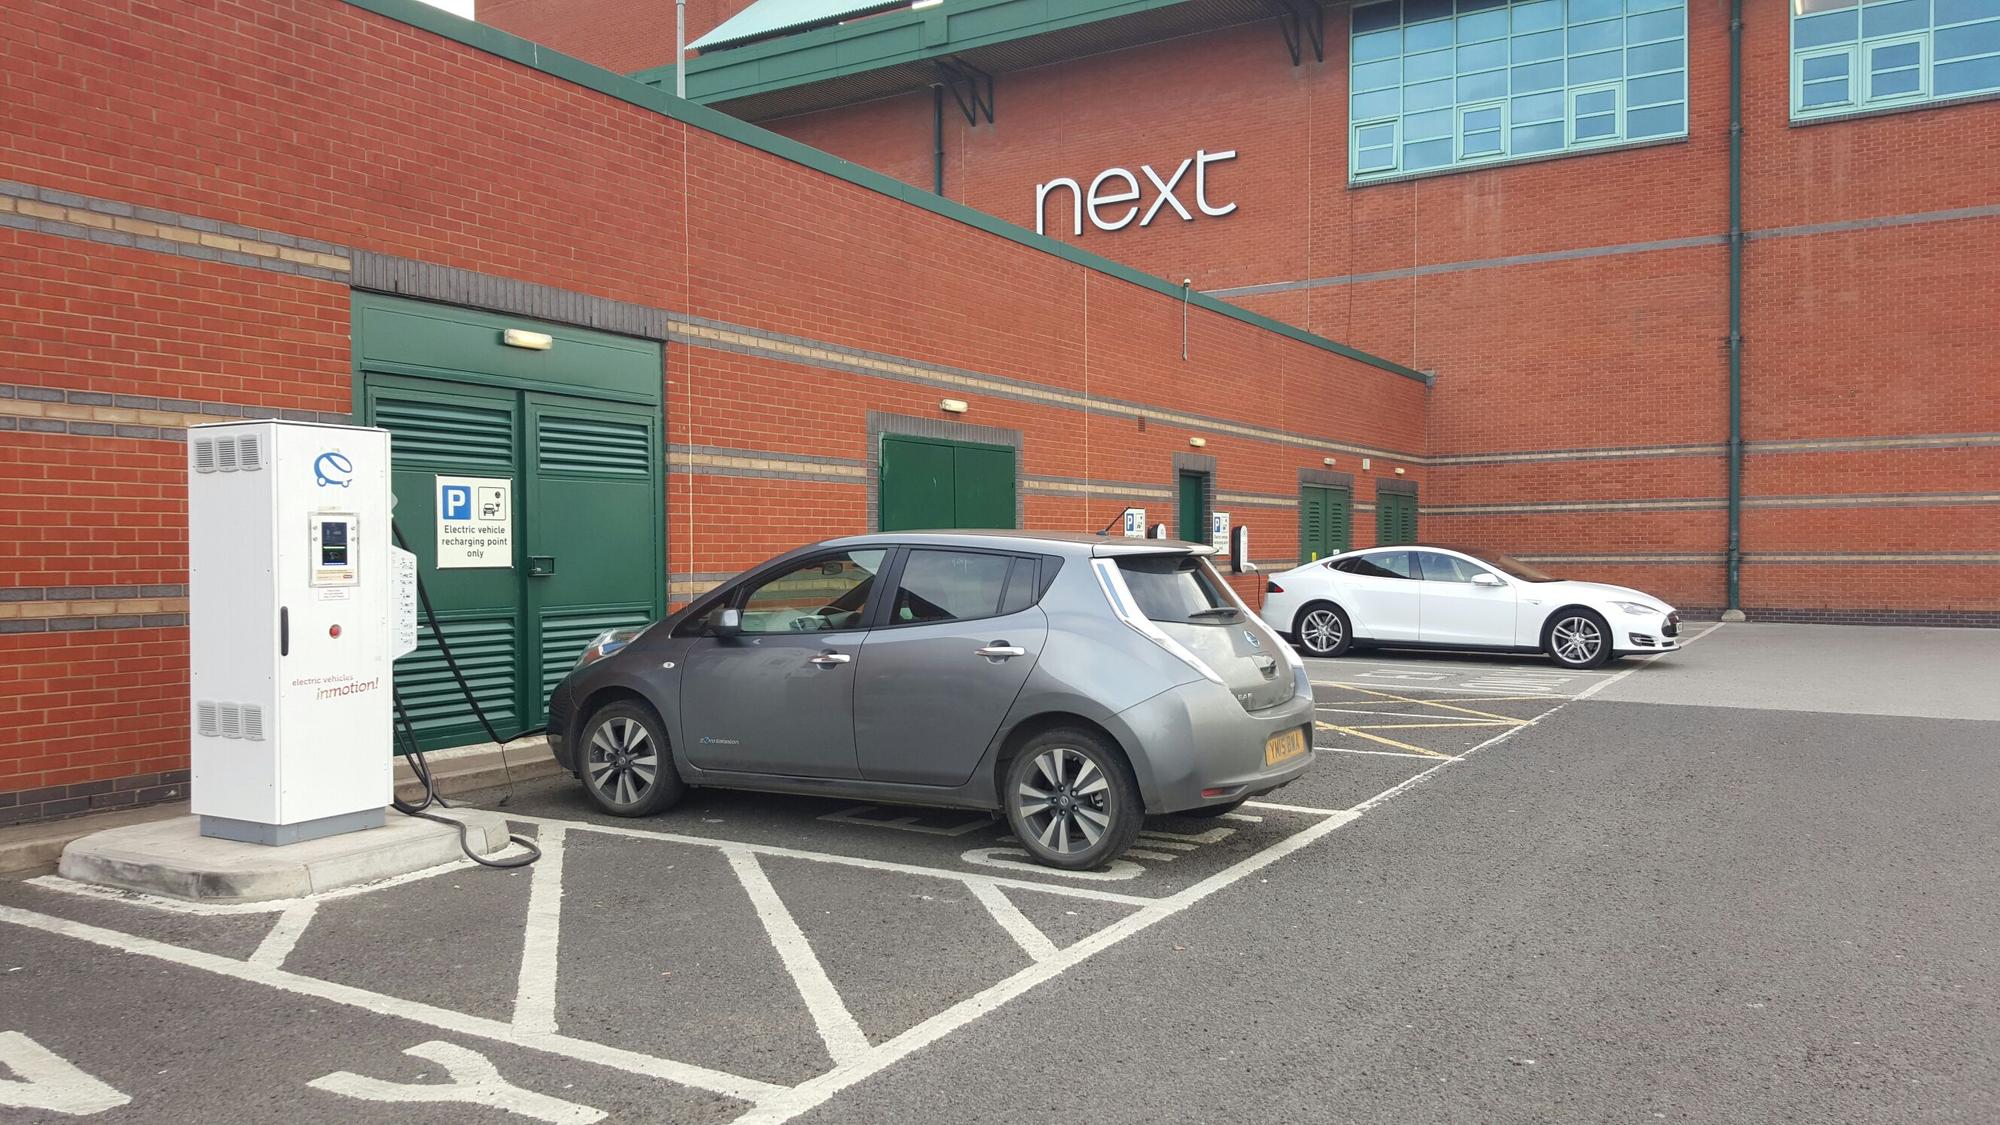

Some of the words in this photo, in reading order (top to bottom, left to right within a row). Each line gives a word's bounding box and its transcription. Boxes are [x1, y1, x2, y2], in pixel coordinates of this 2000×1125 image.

[1036, 150, 1237, 236] next
[447, 489, 466, 517] P
[444, 524, 476, 534] Electric
[477, 525, 506, 534] vehicle
[441, 537, 485, 547] recharging
[487, 537, 508, 547] point
[466, 549, 485, 559] only
[292, 677, 321, 687] electric
[316, 677, 379, 700] inmotion!
